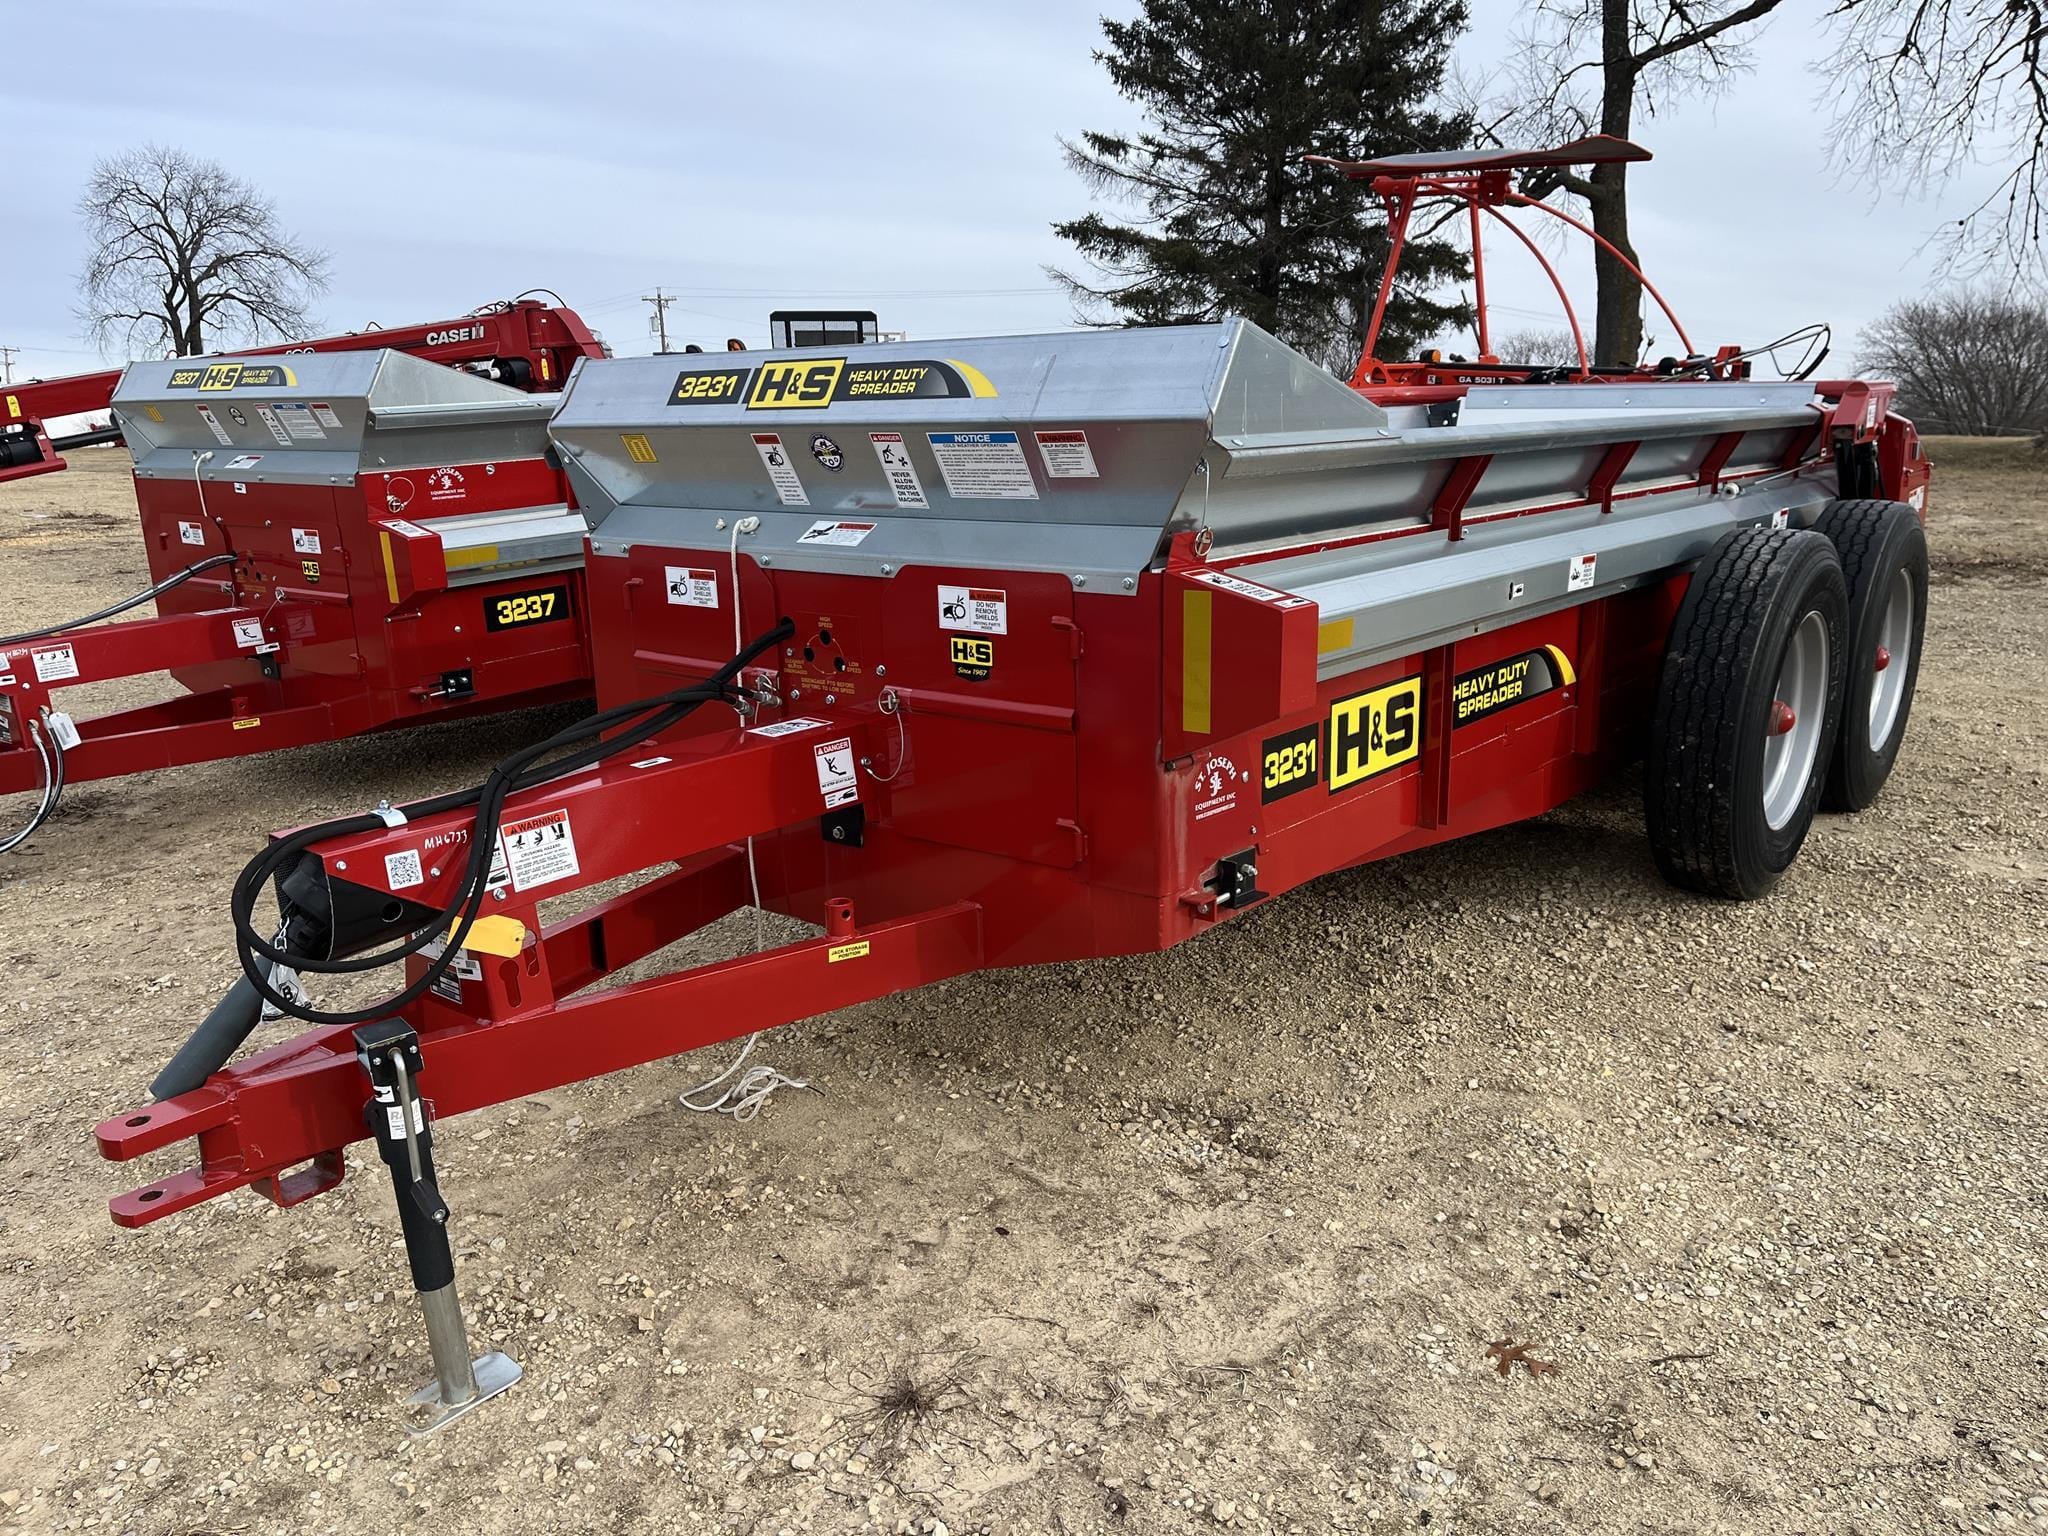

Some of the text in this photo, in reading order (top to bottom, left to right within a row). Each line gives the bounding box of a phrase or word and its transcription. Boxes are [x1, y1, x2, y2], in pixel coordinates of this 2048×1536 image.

[426, 329, 470, 346] CASE
[172, 372, 201, 385] 3237
[848, 367, 929, 383] HEAVY DUTY
[1458, 375, 1472, 384] GA
[1474, 376, 1496, 384] 5031
[677, 375, 739, 398] 3231
[755, 366, 837, 402] H&S
[849, 381, 917, 396] SPREADER
[954, 434, 991, 443] NOTICE
[437, 467, 465, 482] JOSEPH
[496, 592, 556, 625] 3237
[975, 607, 998, 615] REMOVE
[975, 614, 999, 622] SHIELDS
[952, 640, 991, 663] H&S
[957, 666, 988, 677] Since 1967
[1453, 659, 1530, 702] HEAVY DUTY
[1458, 680, 1523, 719] SPREADER
[1336, 690, 1415, 778] H&S
[823, 741, 849, 753] DANGER
[1206, 756, 1237, 780] JOSEPH
[1264, 738, 1317, 789] 3231
[1195, 795, 1226, 811] EQUIPMENT
[1226, 791, 1237, 801] INC
[517, 814, 561, 833] WARNING
[520, 843, 561, 858] CRUSHING HAZARD
[838, 950, 861, 958] POSITION
[845, 944, 868, 952] STORAGE
